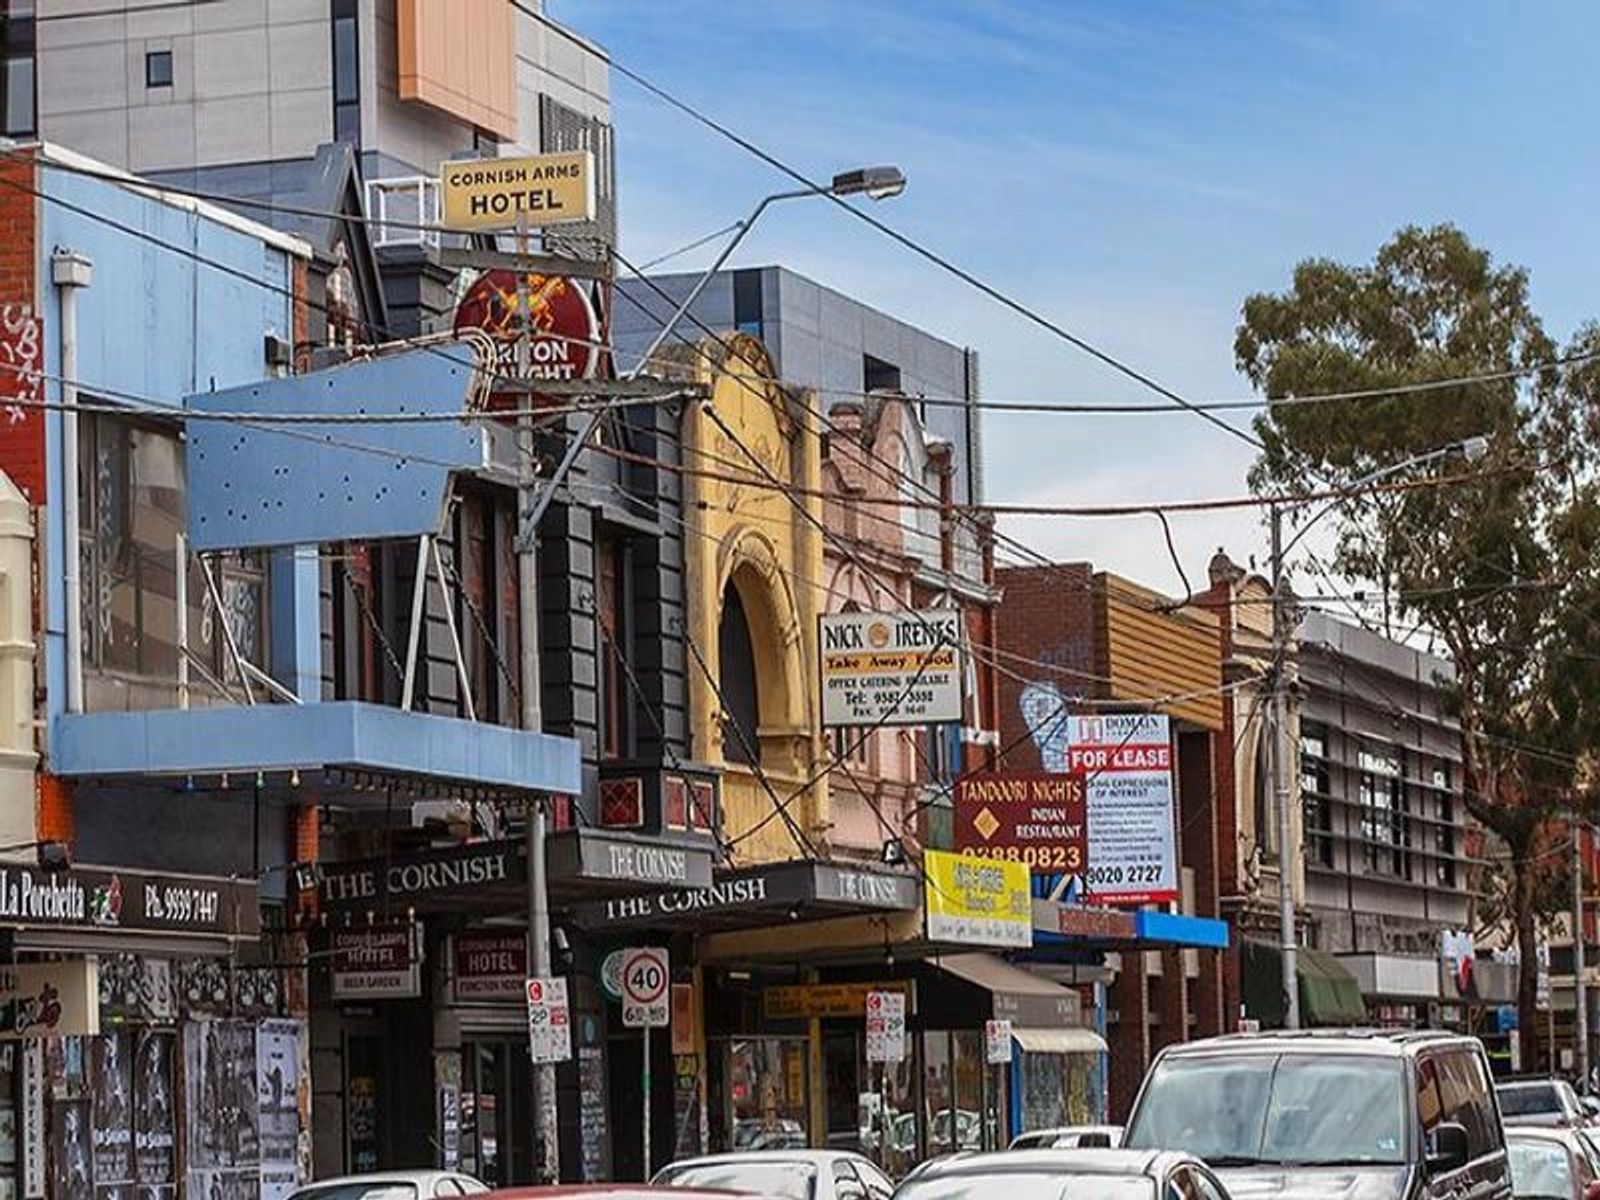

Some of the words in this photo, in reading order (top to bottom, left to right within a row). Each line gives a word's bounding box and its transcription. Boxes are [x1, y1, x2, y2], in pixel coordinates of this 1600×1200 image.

[450, 169, 526, 188] CORNISH
[533, 164, 580, 181] ARMS
[471, 190, 563, 215] HOTEL
[825, 623, 863, 649] NICK
[827, 657, 860, 669] Take
[869, 656, 907, 670] Away
[1072, 750, 1108, 768] FOR
[1113, 749, 1170, 768] LEASE
[960, 780, 1029, 802] TANDOORI
[1033, 780, 1082, 802] NIGHTS
[1031, 808, 1067, 821] INDIAN
[1016, 824, 1082, 838] RESTAURANT
[608, 845, 632, 876] THE
[637, 848, 686, 881] CORNISH
[1024, 846, 1081, 868] 0823
[324, 872, 376, 901] THE
[386, 855, 506, 894] CORNISH
[1127, 865, 1162, 883] 2727
[0, 869, 19, 916] La
[21, 871, 85, 920] Porchetta
[468, 952, 517, 973] HOTEL
[631, 967, 660, 992] 40
